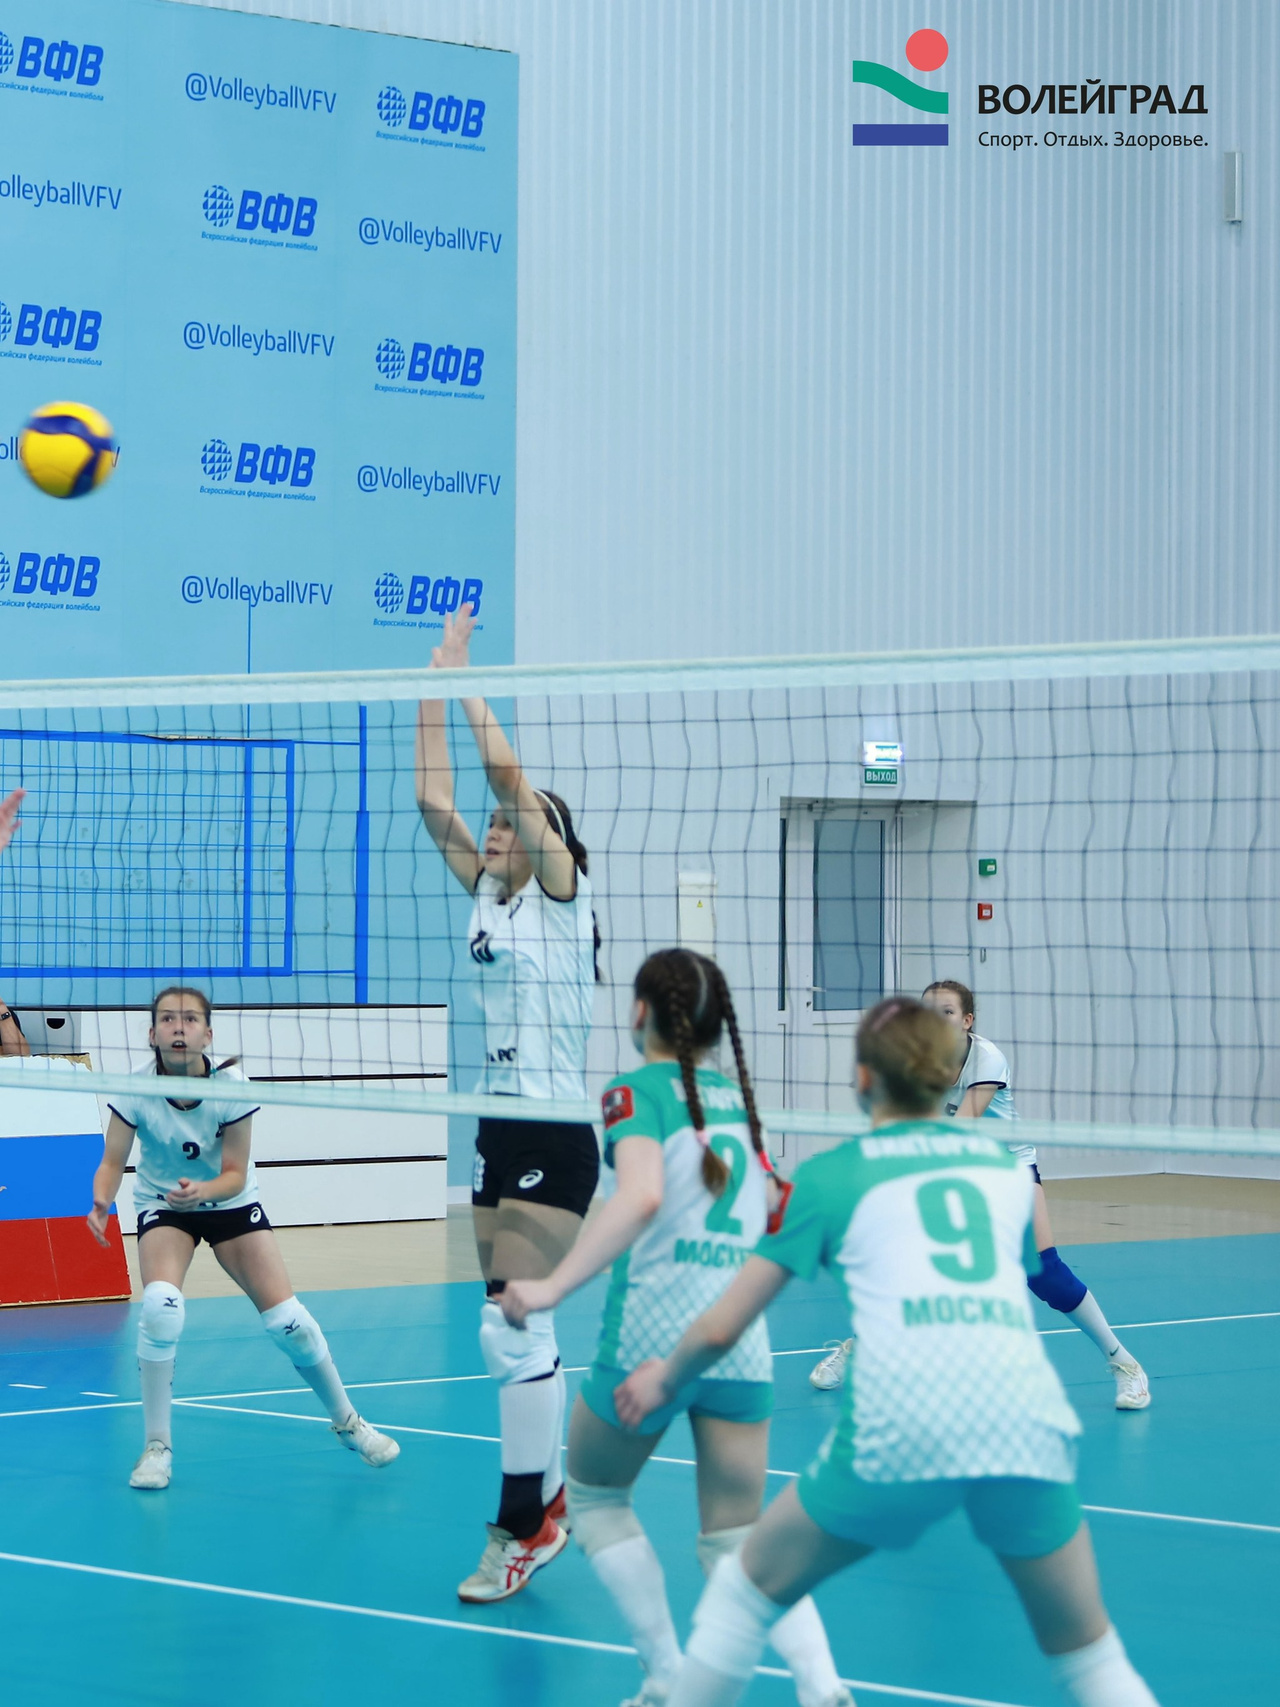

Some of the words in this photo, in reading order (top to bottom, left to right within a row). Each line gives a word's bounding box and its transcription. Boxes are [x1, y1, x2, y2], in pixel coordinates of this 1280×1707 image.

[16, 36, 104, 86] ВФВ
[30, 85, 67, 96] федерация
[69, 92, 104, 101] волейбола
[185, 73, 336, 113] @VolleyballVFV
[408, 91, 485, 138] ВФВ
[236, 190, 318, 237] ВФВ
[359, 217, 502, 253] @VolleyballVFV
[14, 304, 102, 351] ВФВ
[184, 321, 334, 356] @VolleyballVFV
[28, 353, 65, 362] федерация
[68, 358, 102, 366] волейбола
[407, 342, 484, 387] ВФВ
[234, 442, 316, 487] ВФВ
[358, 465, 501, 497] @VolleyballVFV
[12, 552, 100, 597] ВФВ
[182, 575, 333, 606] @VolleyballVFV
[26, 601, 64, 609] федерация
[66, 603, 100, 611] волейбола
[406, 575, 483, 617] ВФВ
[866, 771, 897, 783] ВЫХОД
[704, 1132, 748, 1236] 2
[916, 1178, 997, 1283] 9
